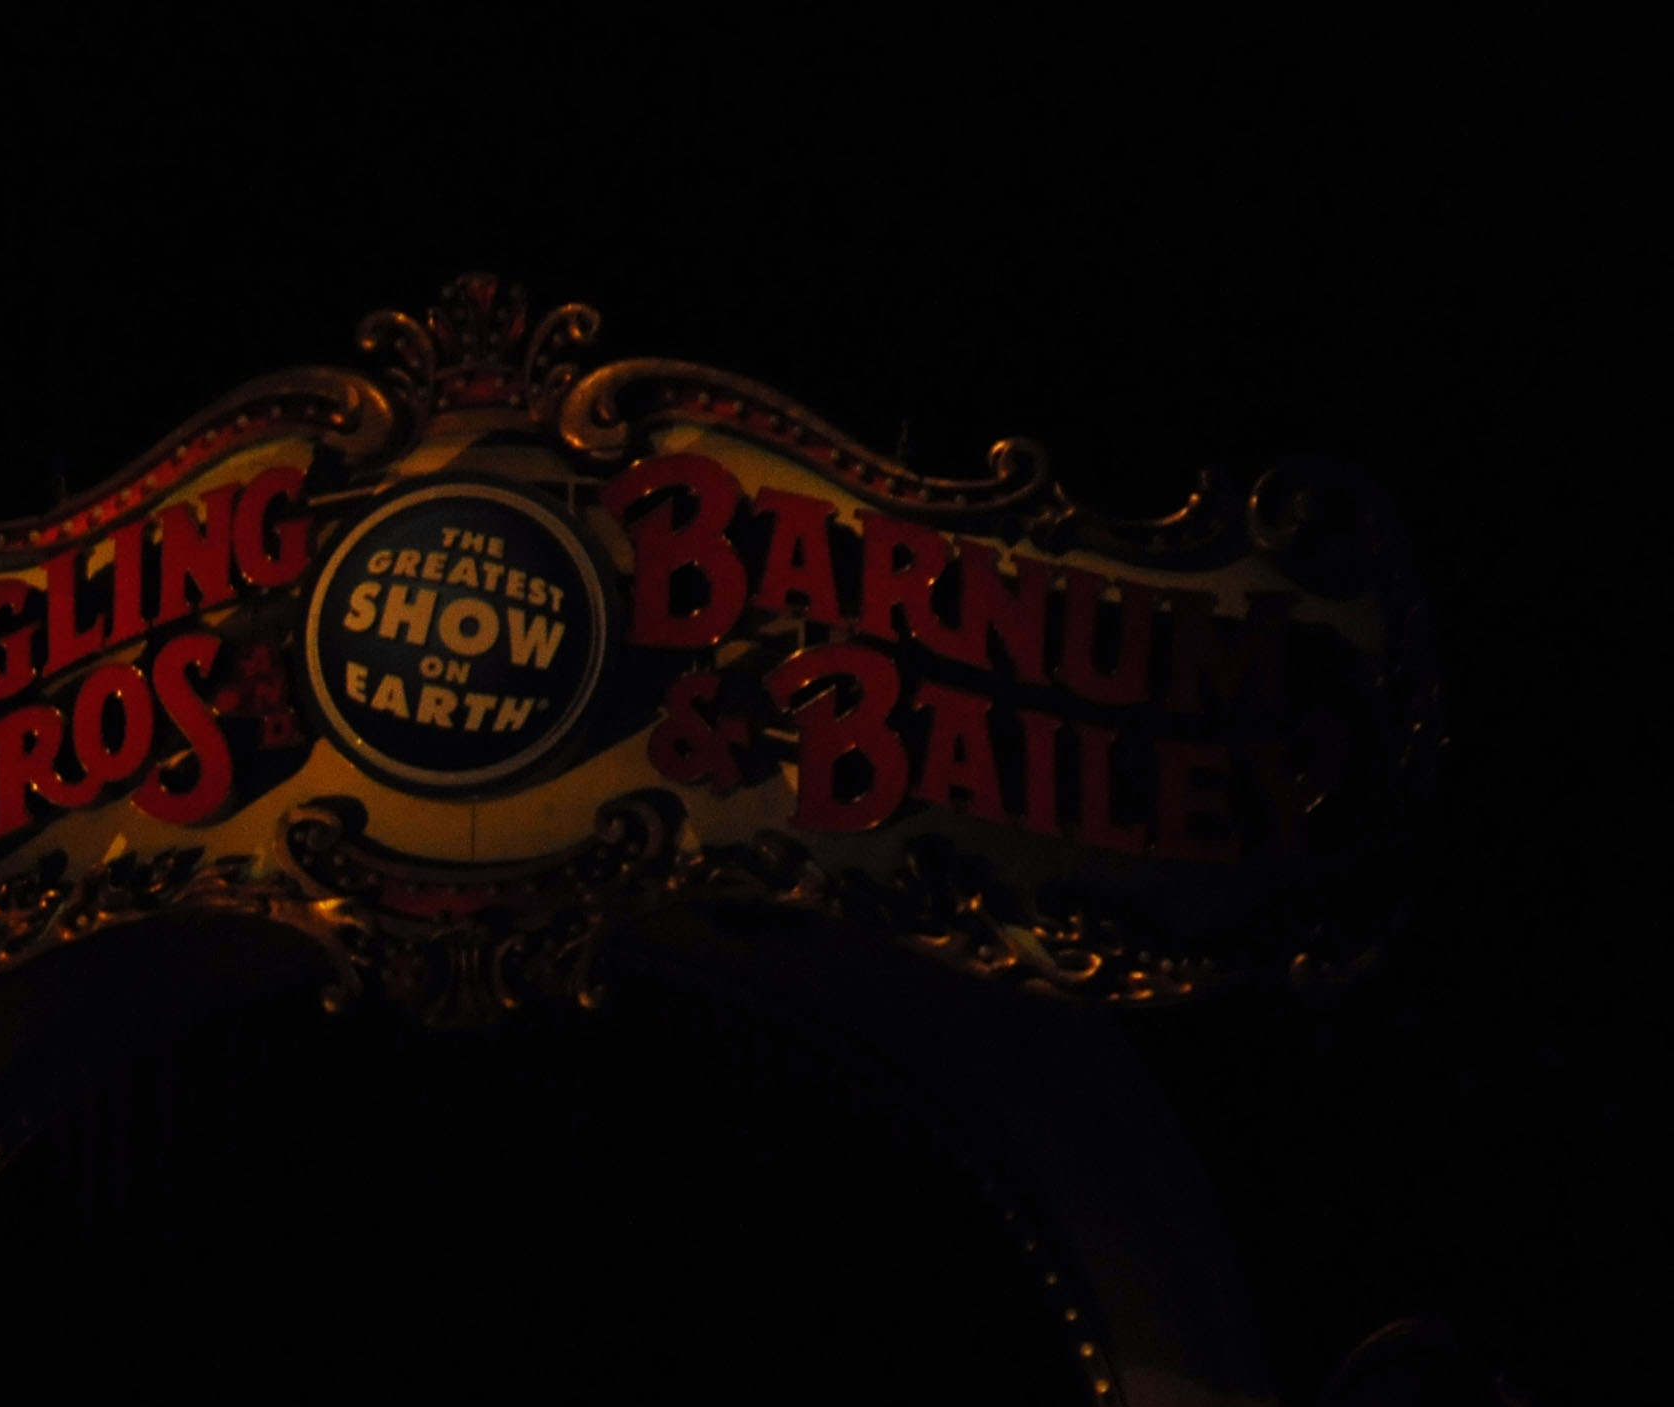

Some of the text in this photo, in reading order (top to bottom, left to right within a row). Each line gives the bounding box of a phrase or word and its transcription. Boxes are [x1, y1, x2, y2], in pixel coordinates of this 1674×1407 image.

[366, 549, 565, 613] GREATEST
[441, 526, 506, 559] THE
[597, 453, 1294, 712] BARNUM
[342, 579, 567, 671] SHOW
[419, 654, 472, 685] ON
[649, 638, 1350, 864] & BAILEY
